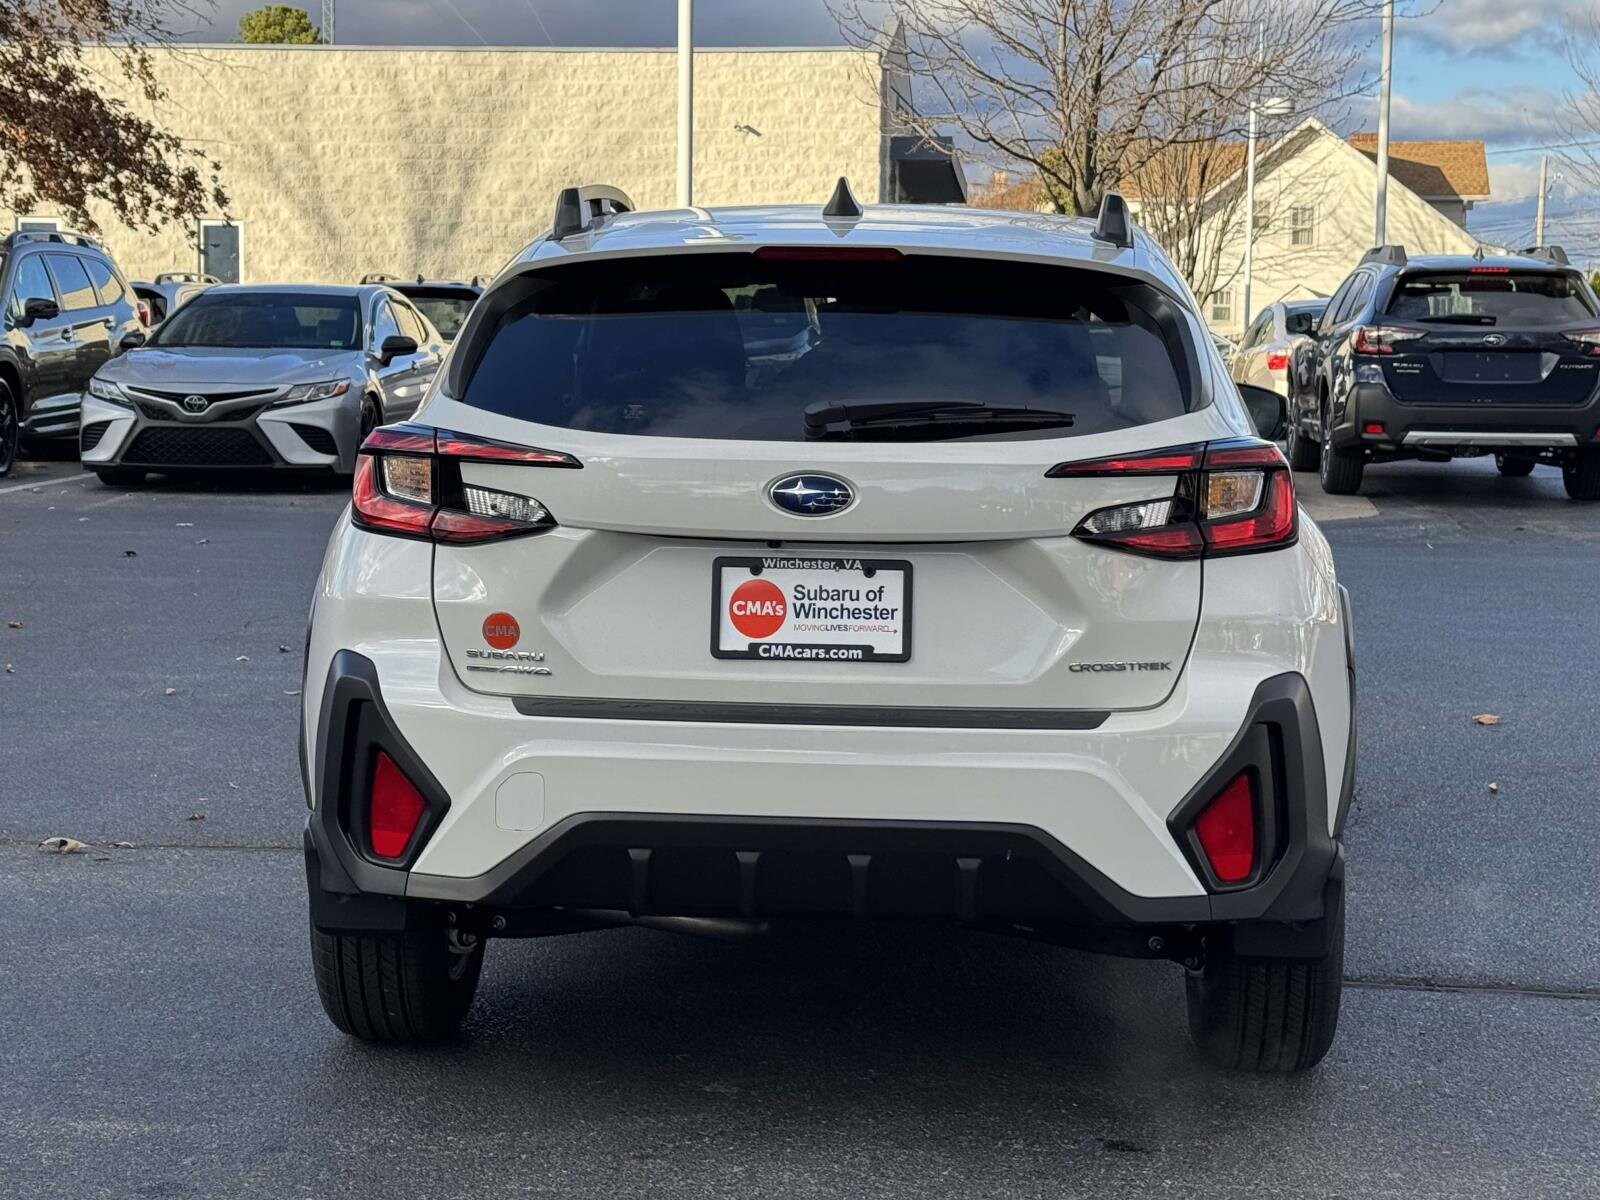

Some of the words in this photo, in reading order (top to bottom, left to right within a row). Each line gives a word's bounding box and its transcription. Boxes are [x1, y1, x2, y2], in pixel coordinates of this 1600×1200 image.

[762, 558, 840, 572] Winchester,
[843, 560, 863, 571] VA
[793, 584, 861, 602] Subaru
[865, 586, 885, 602] of
[732, 600, 784, 617] CMA's
[793, 603, 899, 621] Winchester
[484, 625, 518, 637] CMA
[466, 649, 546, 662] SUBARU
[758, 645, 863, 660] CMAcars.com
[1068, 661, 1172, 673] CROSSTREK
